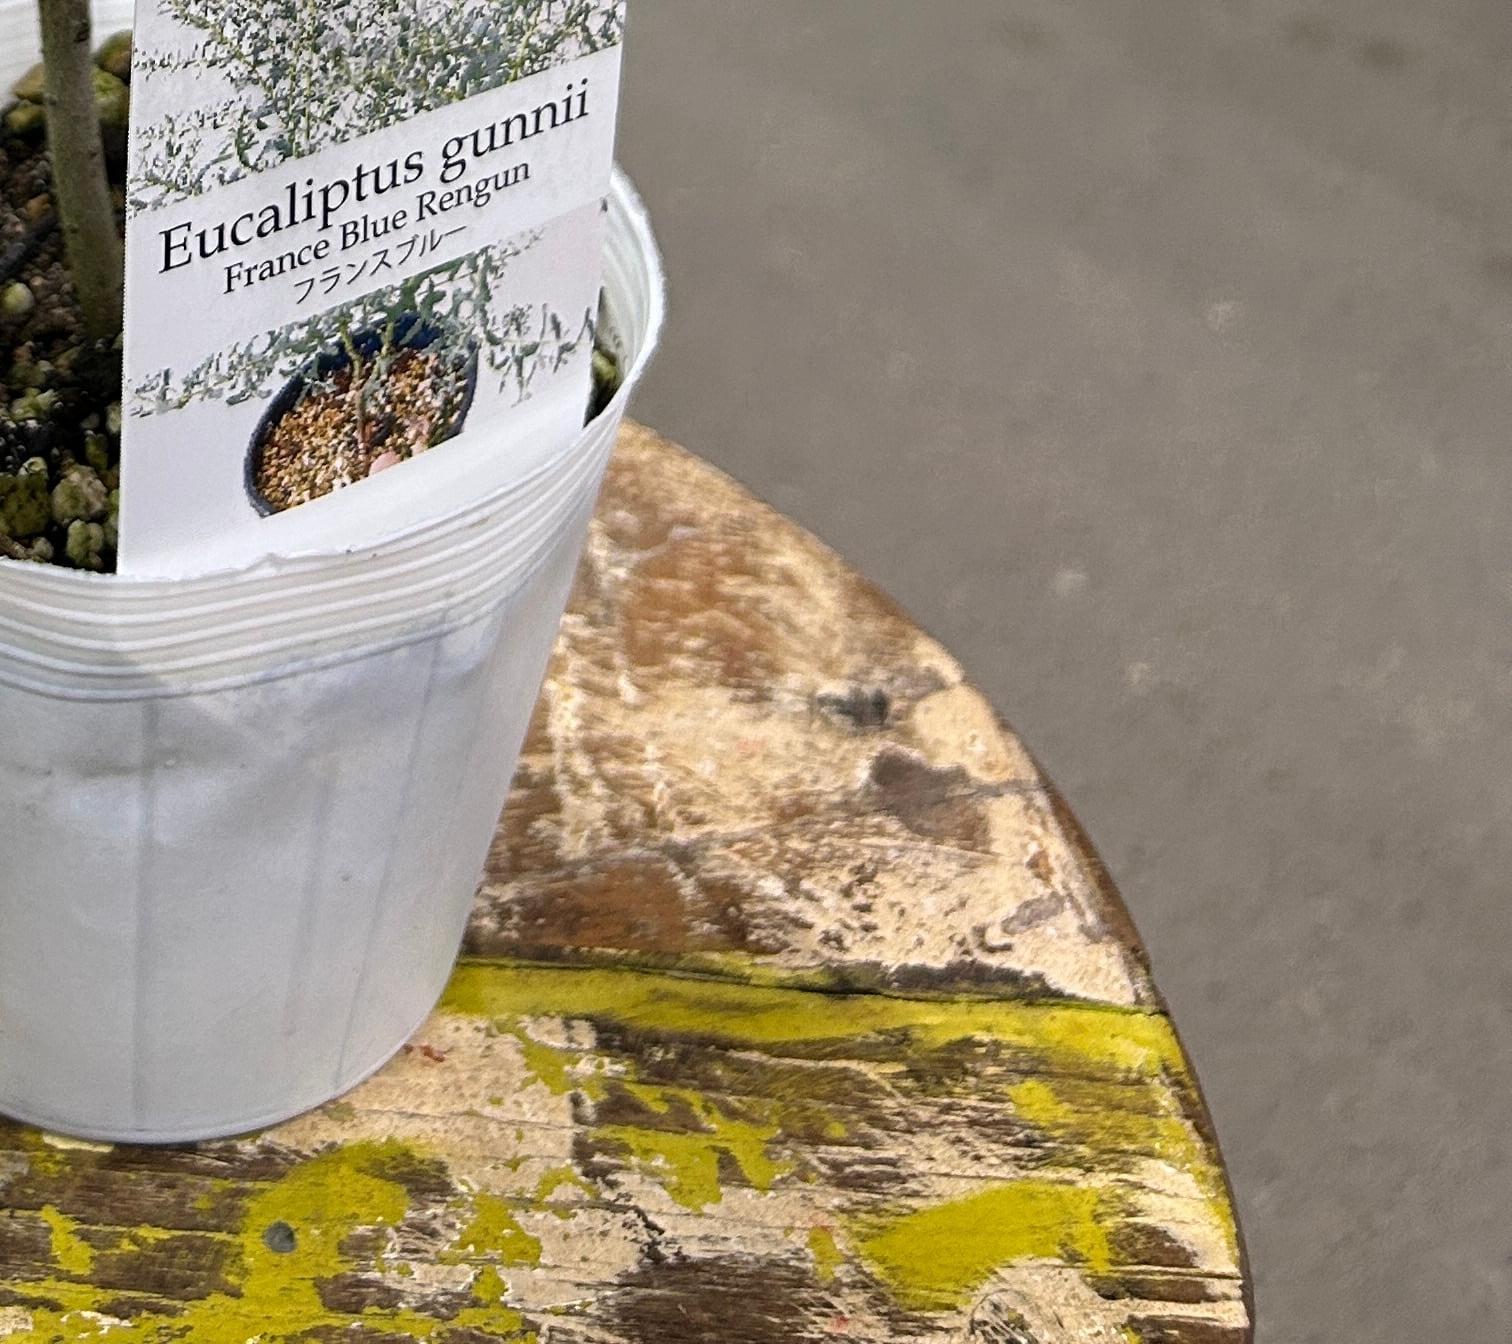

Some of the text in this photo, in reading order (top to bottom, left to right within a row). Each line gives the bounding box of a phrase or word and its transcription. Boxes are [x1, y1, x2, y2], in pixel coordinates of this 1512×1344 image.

[158, 78, 590, 274] Eucaliptus gunnii
[223, 160, 531, 295] France Blue Rengun
[295, 224, 468, 304] フランスブルー
